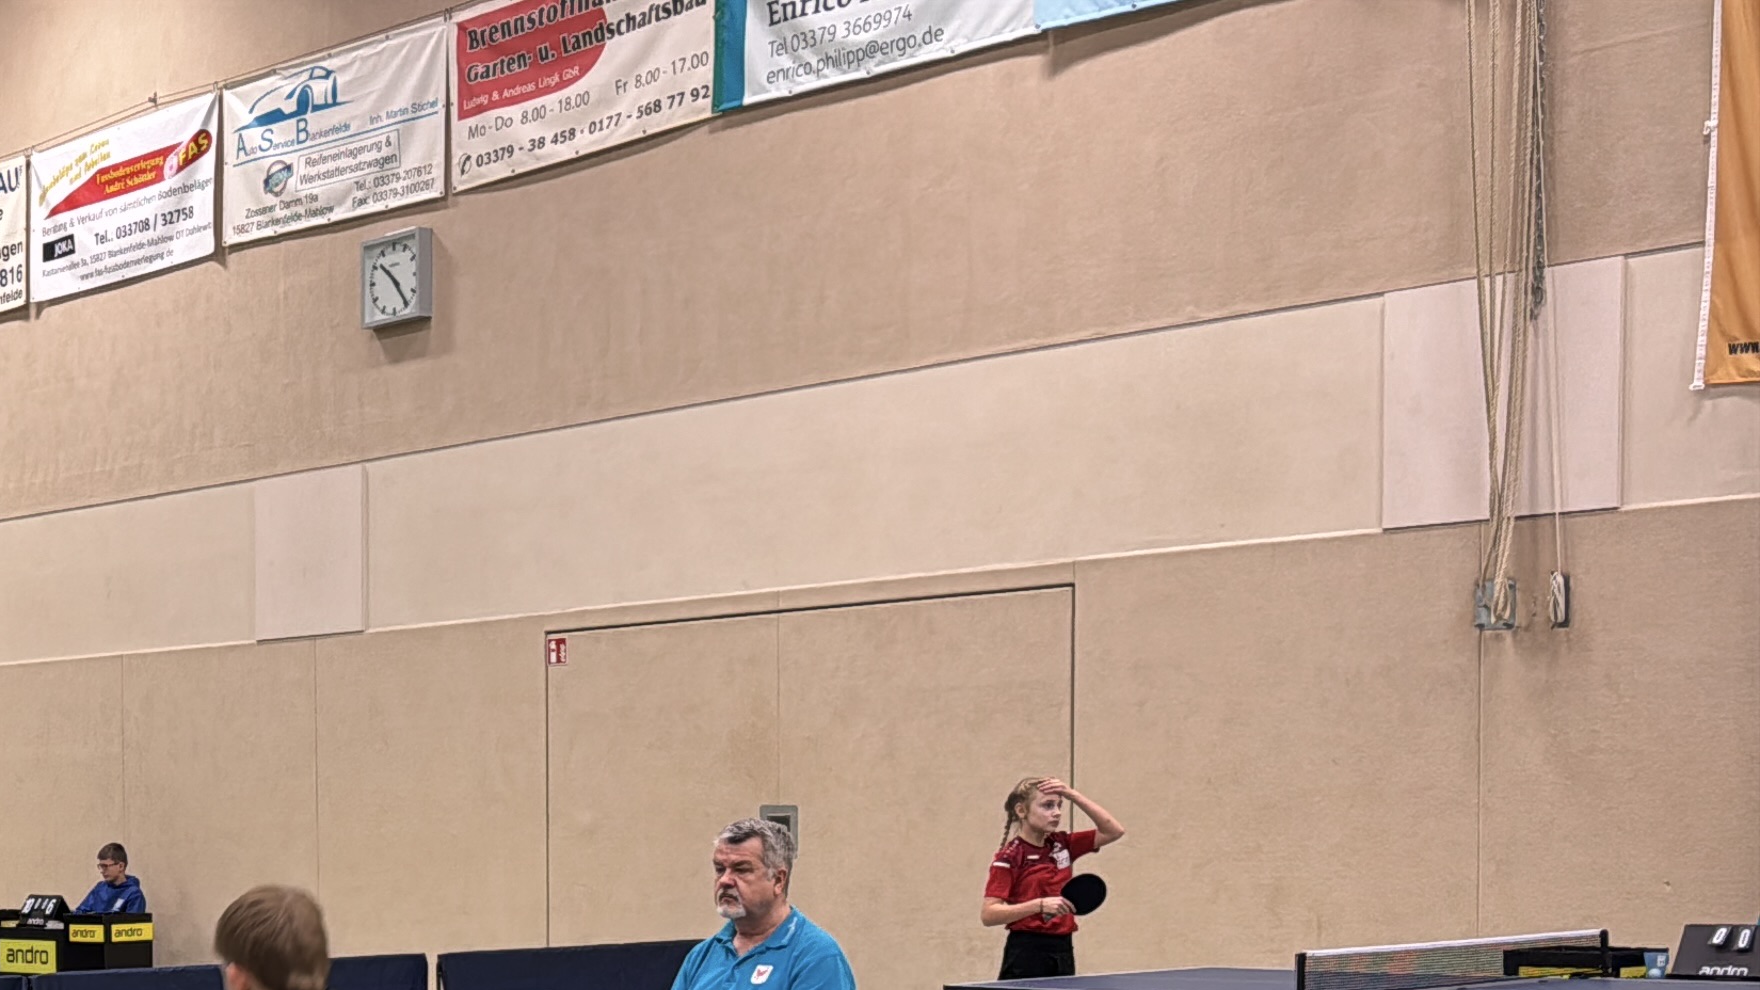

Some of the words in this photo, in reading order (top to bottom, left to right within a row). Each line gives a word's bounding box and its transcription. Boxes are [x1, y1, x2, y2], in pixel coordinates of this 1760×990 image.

[768, 37, 789, 58] Tel
[791, 24, 837, 52] 03379
[841, 4, 913, 39] 3669974
[466, 52, 532, 84] Garten-
[538, 45, 556, 62] u.
[766, 26, 945, 84] enrico.philipp@ergo.de
[502, 81, 536, 99] Andreas
[614, 79, 628, 95] Fr
[475, 145, 514, 168] 03379
[528, 136, 546, 152] 38
[551, 128, 577, 146] 458
[588, 112, 621, 135] 0177
[636, 99, 662, 119] 568
[667, 92, 685, 109] 77
[690, 84, 710, 102] 92
[179, 132, 209, 167] FAS
[304, 140, 383, 169] Reifeneinlagerung
[77, 208, 103, 226] Verkauf
[105, 206, 118, 218] von
[115, 218, 151, 240] 033708
[160, 205, 194, 227] 32758
[232, 222, 254, 236] 15827
[54, 239, 73, 258] JOKA
[114, 927, 143, 938] andro
[1711, 927, 1728, 944] 0
[1738, 928, 1751, 948] 0
[6, 946, 49, 965] andro
